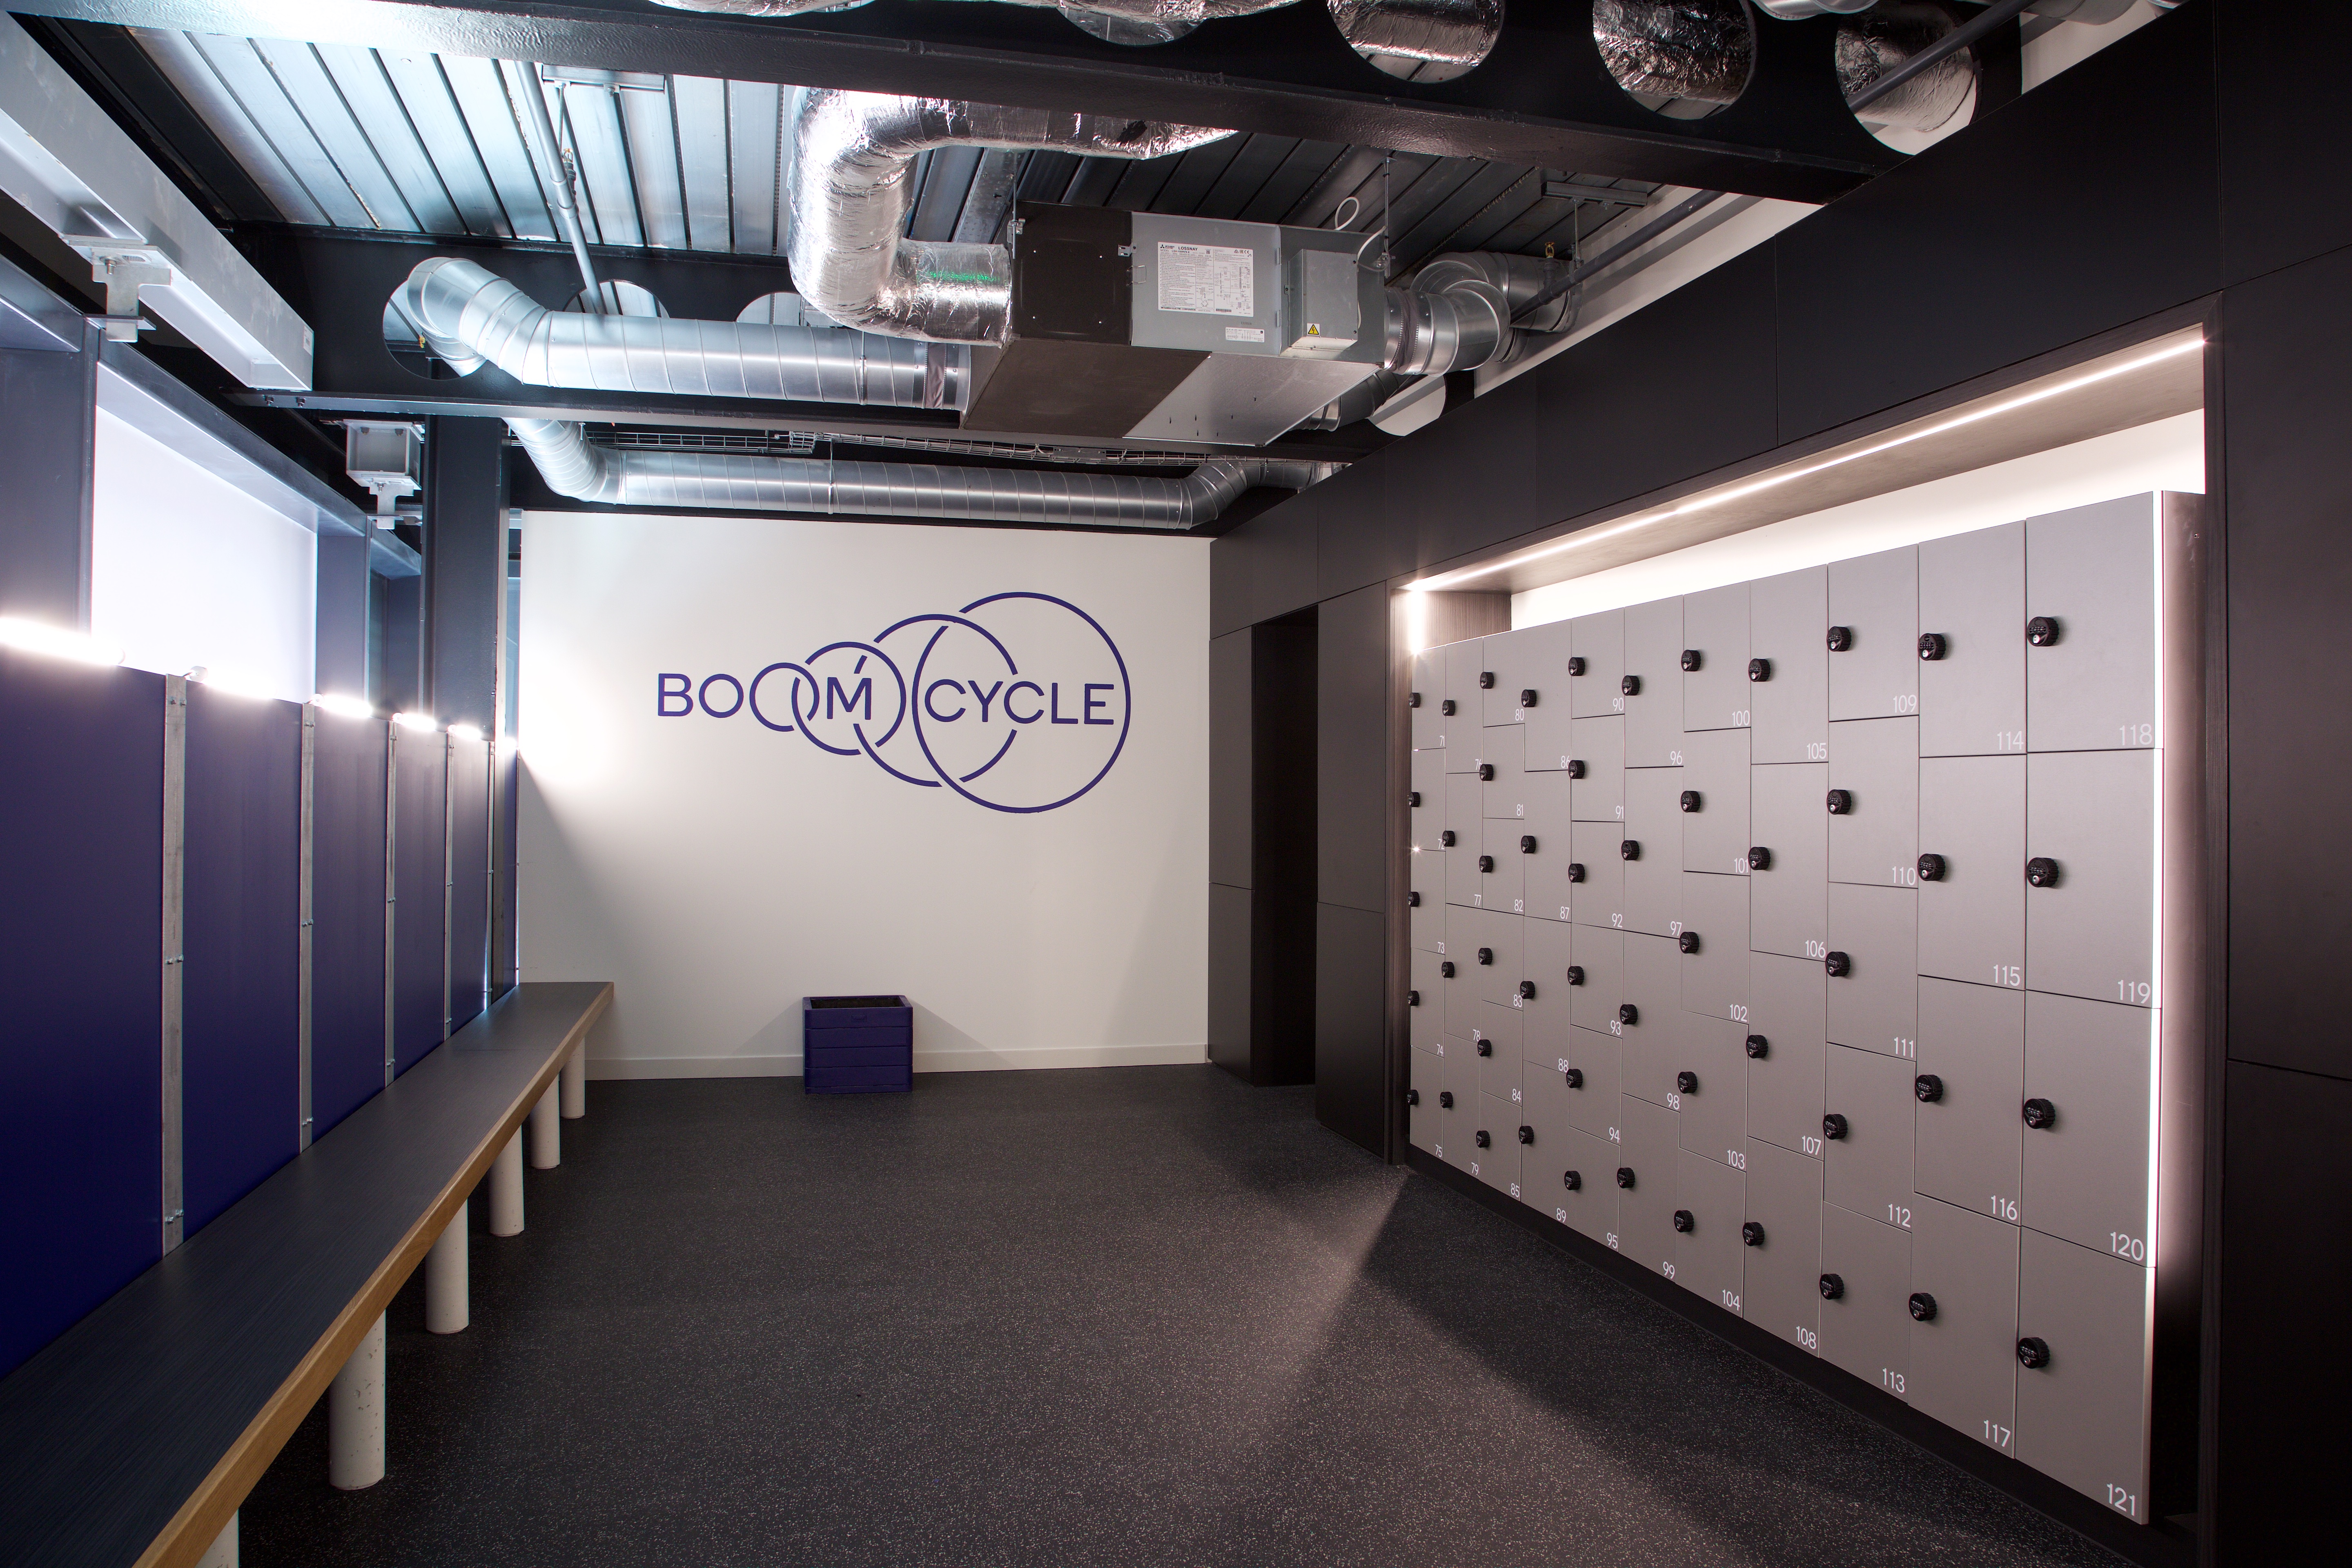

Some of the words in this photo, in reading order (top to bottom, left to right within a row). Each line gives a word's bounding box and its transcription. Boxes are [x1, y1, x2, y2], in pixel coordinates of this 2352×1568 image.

[657, 662, 872, 732] BOOM
[924, 678, 1114, 725] CYCLE
[1613, 697, 1624, 712] 90
[1893, 694, 1917, 713] 109
[1515, 708, 1524, 721] 80
[1732, 710, 1750, 726] 100
[1439, 735, 1445, 746] 71
[1997, 731, 2024, 750] 114
[2119, 724, 2152, 746] 118
[1670, 750, 1683, 765] 96
[1806, 742, 1827, 760] 105
[1475, 759, 1482, 770] 76
[1561, 755, 1570, 768] 86
[1517, 804, 1523, 816] 81
[1615, 805, 1624, 819] 91
[1734, 858, 1748, 873] 101
[1892, 866, 1916, 886] 110
[1474, 894, 1481, 906] 77
[1514, 899, 1523, 912] 82
[1560, 906, 1570, 920] 87
[1612, 913, 1623, 928] 92
[1670, 921, 1682, 936] 97
[1437, 941, 1445, 953] 73
[1805, 940, 1826, 958] 106
[1993, 964, 2020, 986] 115
[2118, 980, 2150, 1004] 119
[1513, 994, 1522, 1008] 83
[1730, 1004, 1747, 1022] 102
[1472, 1029, 1481, 1042] 78
[1610, 1020, 1621, 1036] 93
[1437, 1044, 1443, 1056] 74
[1894, 1037, 1913, 1058] 111
[1558, 1058, 1568, 1073] 88
[1512, 1088, 1521, 1102] 84
[1667, 1093, 1679, 1110] 98
[1609, 1127, 1620, 1143] 94
[1435, 1144, 1442, 1158] 75
[1802, 1135, 1821, 1155] 107
[1727, 1149, 1745, 1169] 103
[1471, 1162, 1479, 1176] 79
[1510, 1183, 1520, 1198] 85
[1556, 1207, 1566, 1223] 89
[1888, 1203, 1911, 1228] 112
[1991, 1195, 2018, 1221] 116
[1607, 1232, 1618, 1249] 95
[2110, 1232, 2144, 1261] 120
[1663, 1261, 1675, 1279] 99
[1722, 1289, 1740, 1311] 104
[1796, 1325, 1816, 1349] 108
[1882, 1368, 1905, 1393] 113
[1984, 1420, 2011, 1447] 117
[2106, 1483, 2136, 1516] 121
